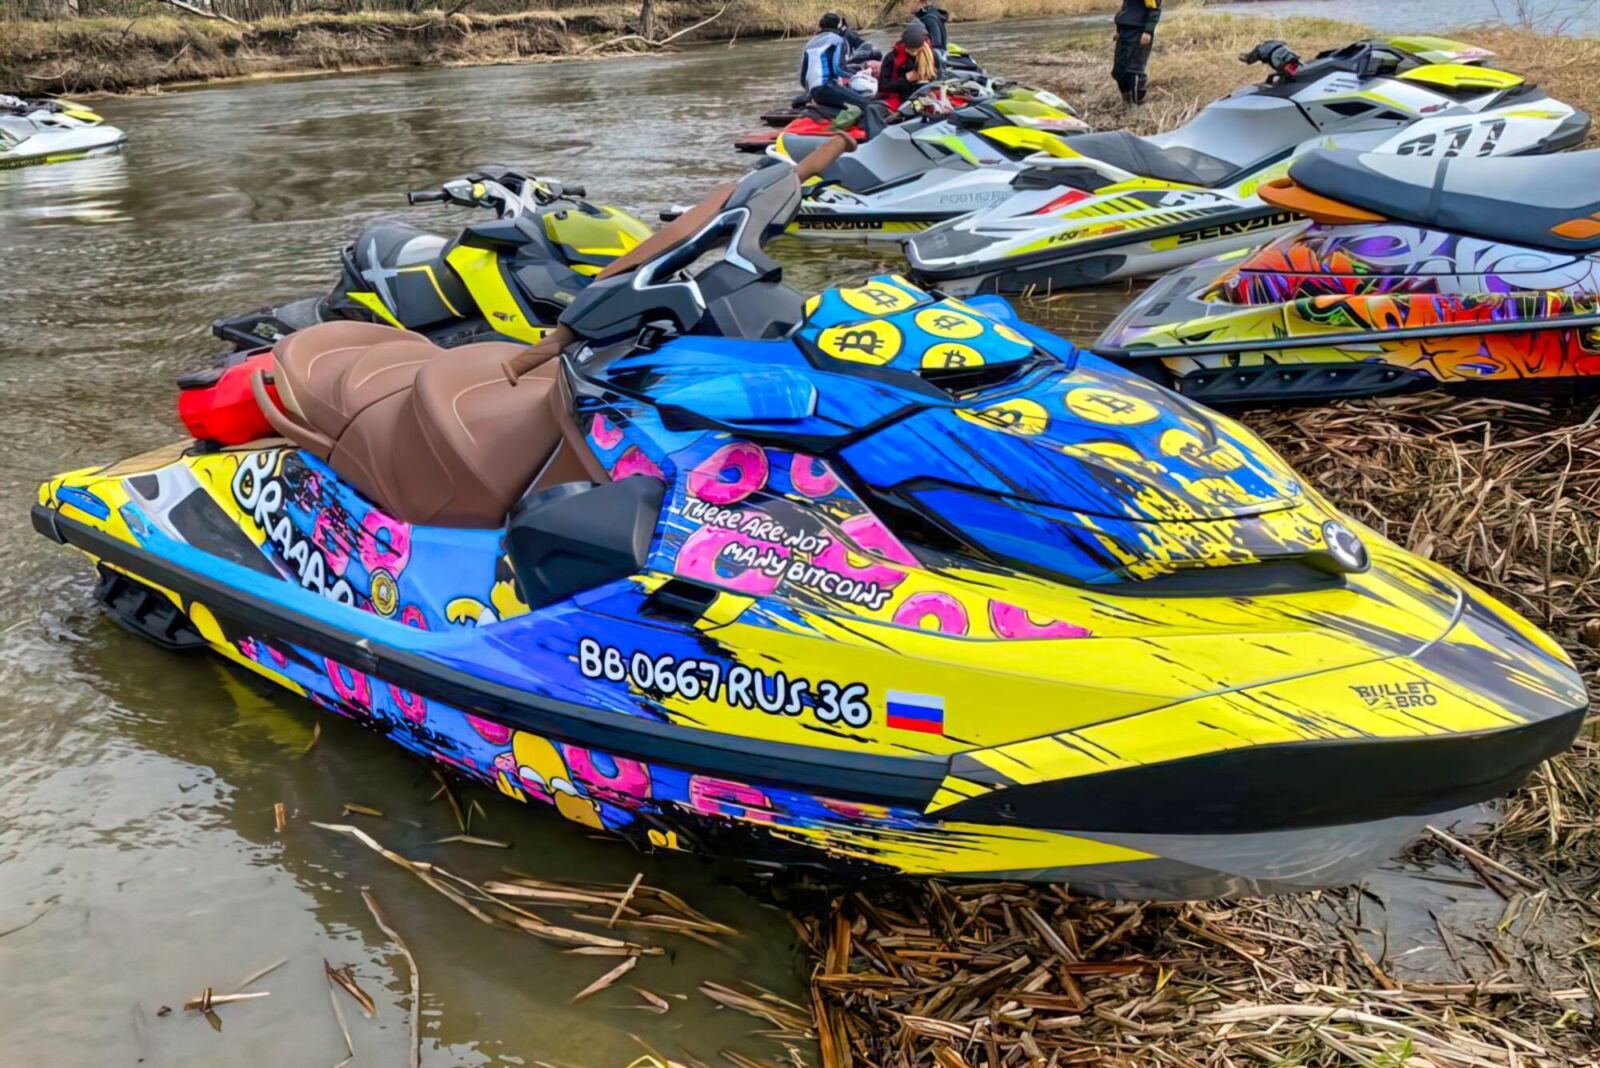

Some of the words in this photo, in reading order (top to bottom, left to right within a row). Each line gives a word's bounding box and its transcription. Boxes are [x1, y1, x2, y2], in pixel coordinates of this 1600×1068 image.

[678, 496, 744, 529] THERE
[723, 541, 787, 575] MANY
[786, 565, 892, 609] BITCOINS
[580, 638, 625, 681] BB
[631, 652, 720, 700] 0667
[728, 666, 808, 714] RUS
[816, 682, 870, 726] 36
[1395, 694, 1437, 708] BRO
